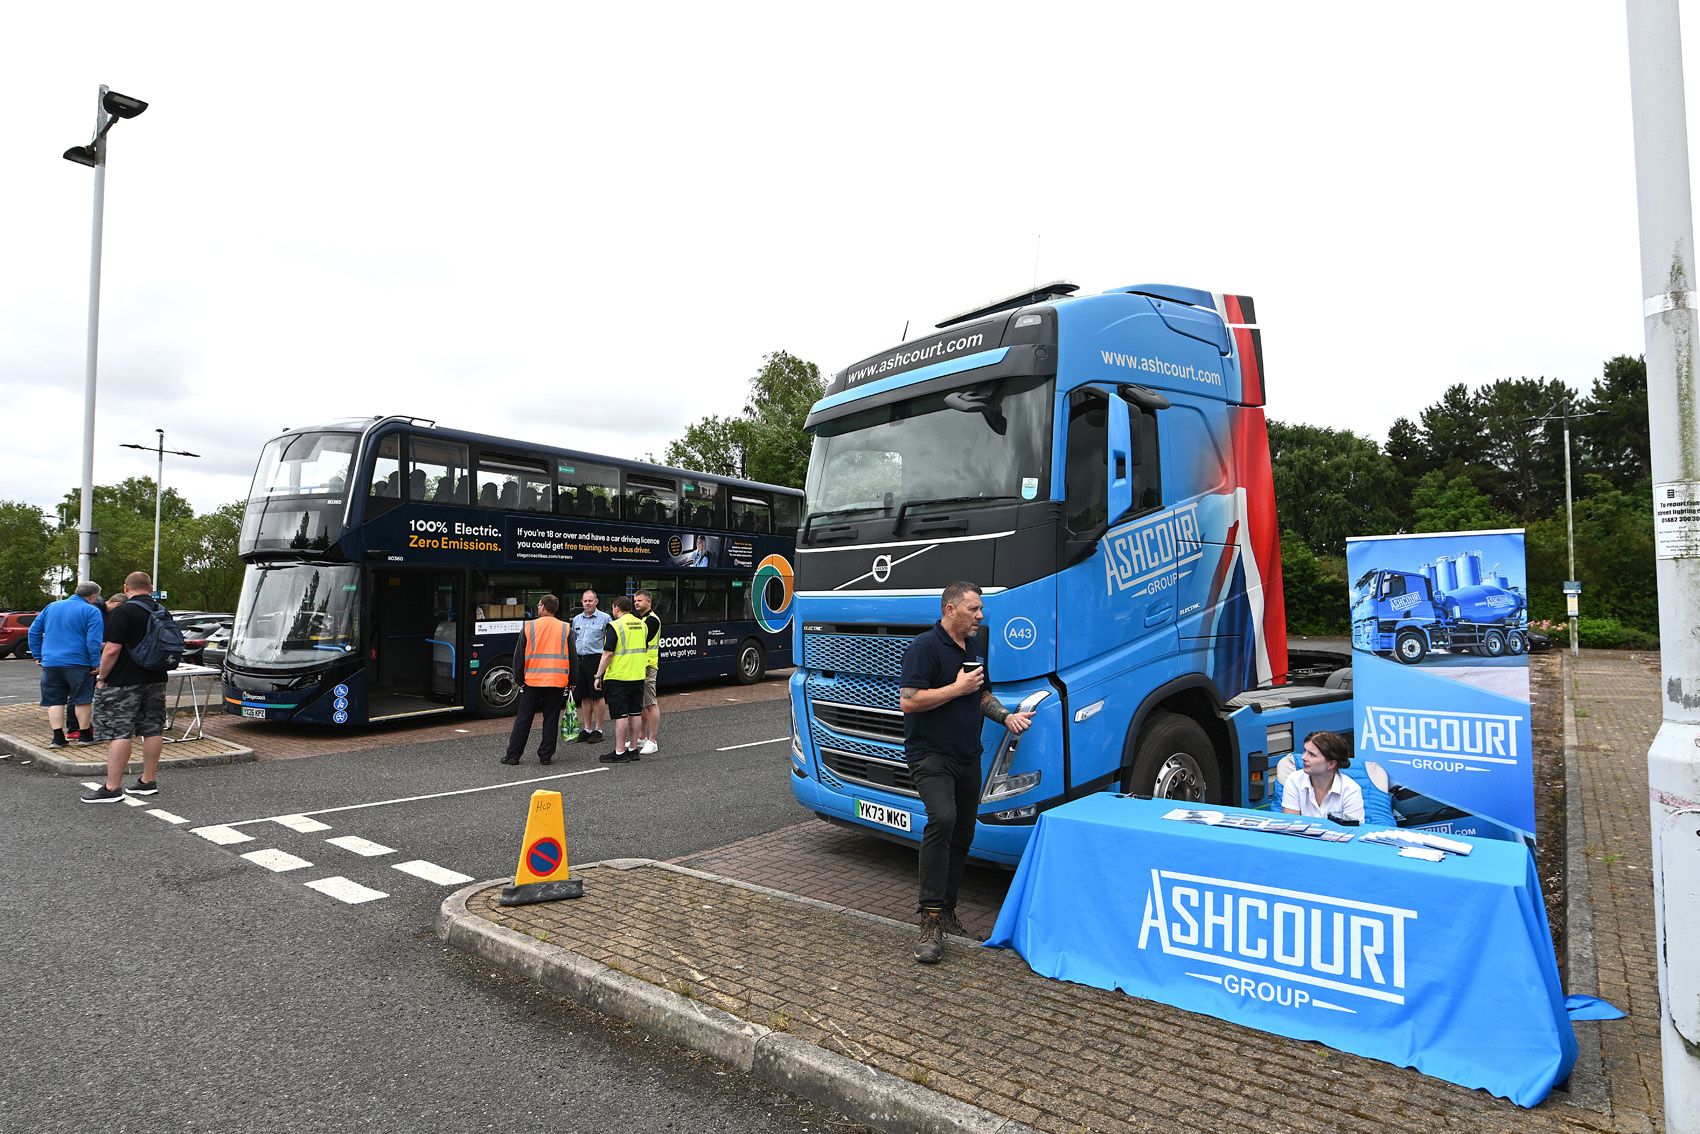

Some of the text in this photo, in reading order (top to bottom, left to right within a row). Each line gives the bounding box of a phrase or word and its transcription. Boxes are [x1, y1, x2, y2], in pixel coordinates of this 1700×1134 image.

[848, 333, 983, 384] www.ashcourt.com
[1101, 350, 1221, 385] www.ashcourt.com
[409, 520, 502, 538] 100% Electric.
[517, 527, 523, 536] If
[523, 528, 546, 538] you're
[546, 530, 554, 538] 18
[562, 532, 577, 540] over
[578, 532, 590, 540] and
[591, 533, 605, 541] have
[621, 534, 640, 545] driving
[641, 536, 660, 544] licence
[409, 535, 502, 552] Zero Emissions.
[517, 541, 530, 549] you
[531, 541, 551, 549] could
[552, 542, 564, 551] get
[564, 542, 577, 550] free
[578, 543, 602, 553] training
[602, 544, 609, 552] to
[623, 545, 634, 553] bus
[1102, 502, 1203, 596] ASHCOURT
[1147, 573, 1178, 595] GROUP
[1180, 603, 1201, 615] ELECTRIC
[1008, 627, 1032, 639] A43
[677, 650, 687, 658] got
[687, 648, 697, 656] you
[1361, 706, 1524, 765] ASHCOURT
[1412, 758, 1465, 773] GROUP
[860, 802, 907, 828] YK73 WKG
[1138, 868, 1418, 1006] ASHCOURT
[1224, 974, 1310, 1008] GROUP
